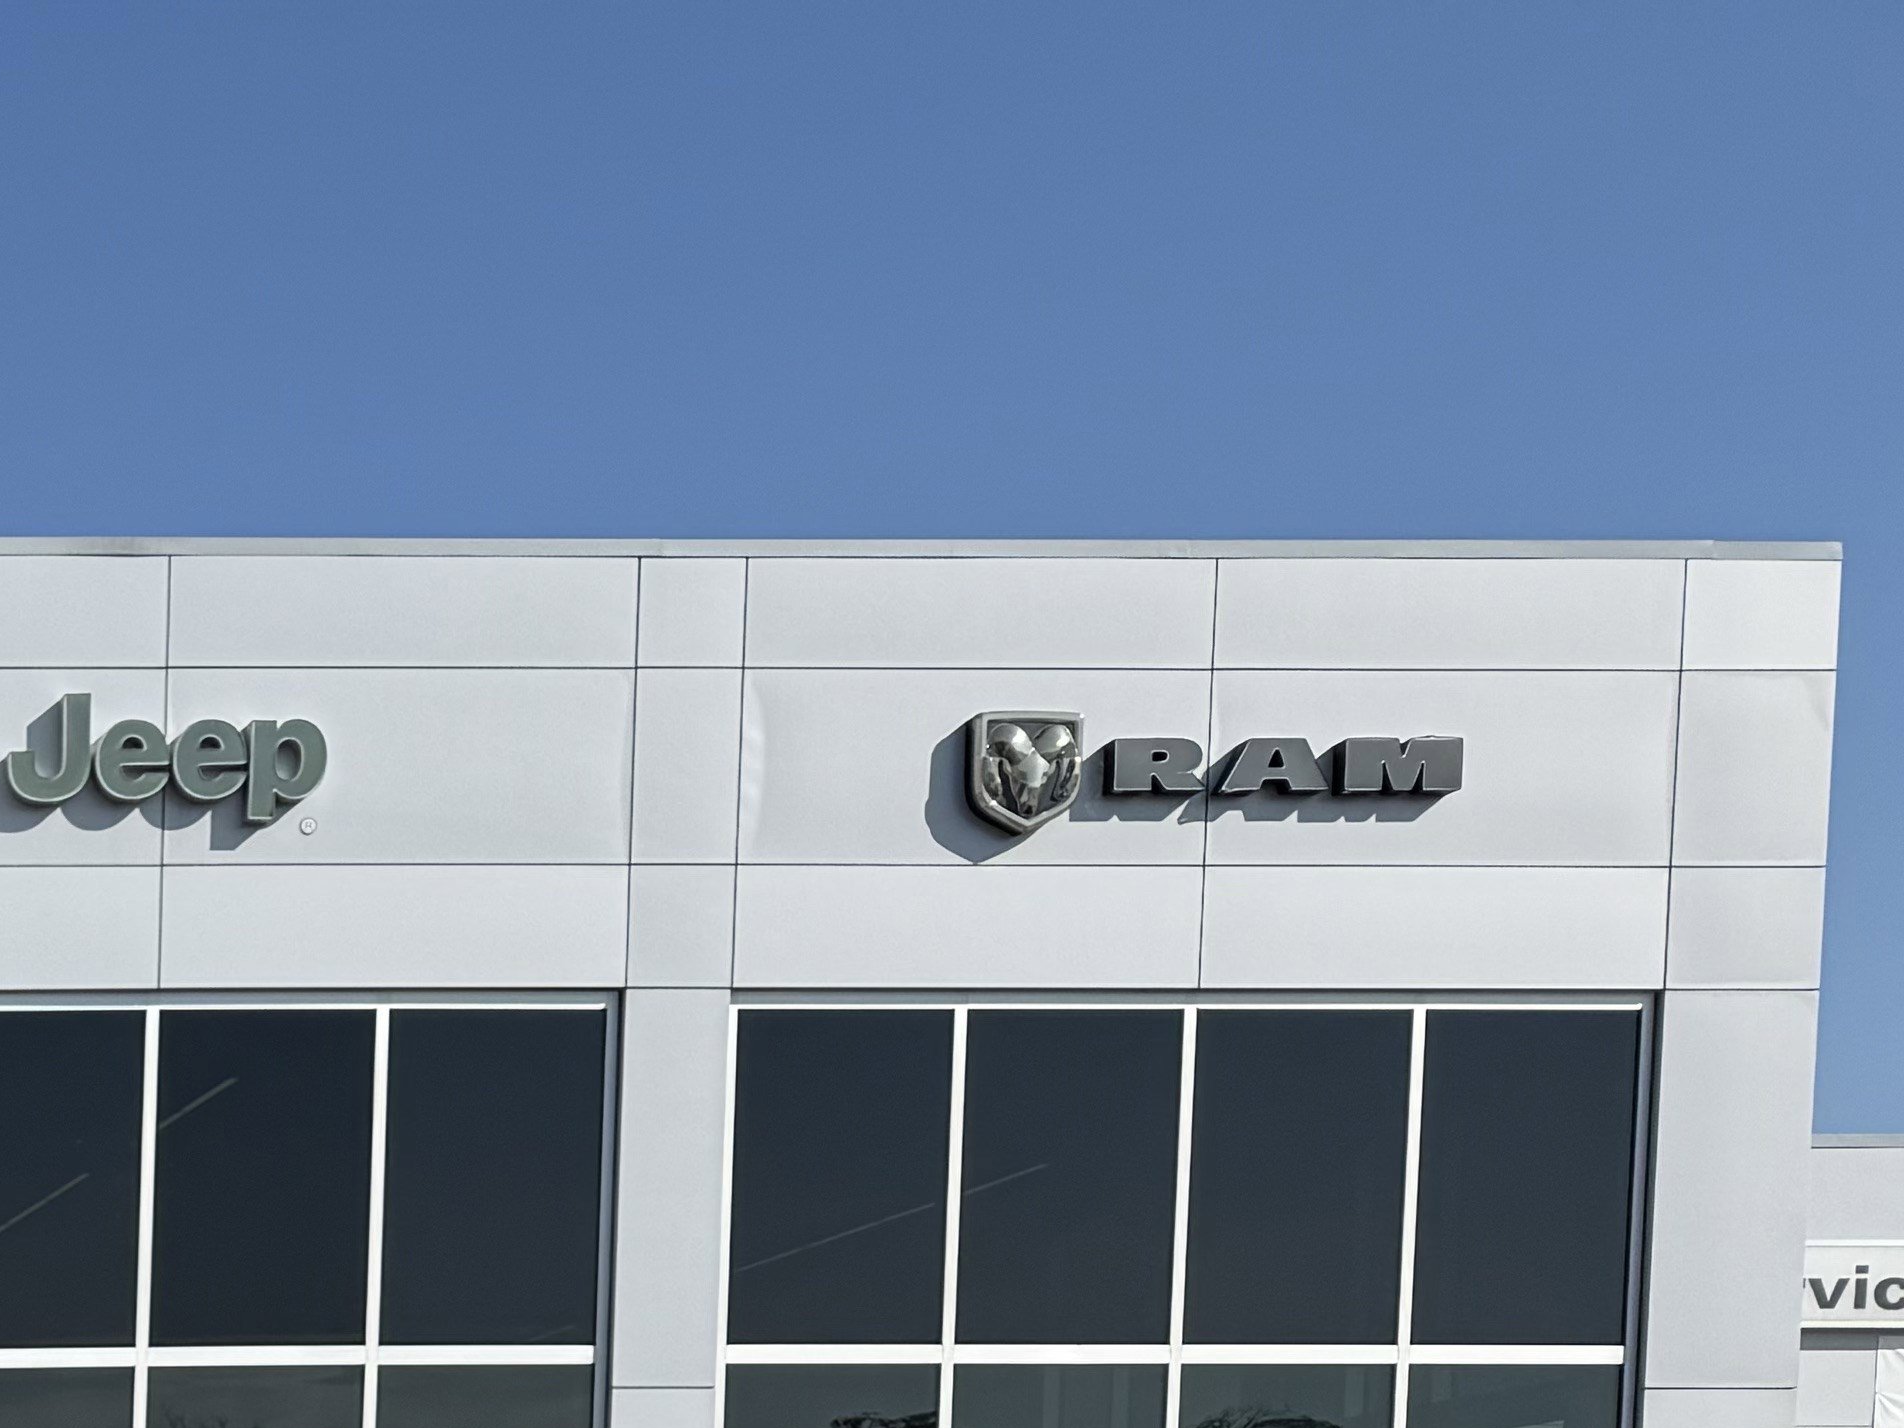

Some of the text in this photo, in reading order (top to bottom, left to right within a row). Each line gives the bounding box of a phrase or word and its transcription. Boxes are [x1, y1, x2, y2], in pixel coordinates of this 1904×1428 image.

[6, 692, 328, 822] Jeep
[1106, 735, 1465, 795] RAM
[1803, 1264, 1904, 1311] vic
